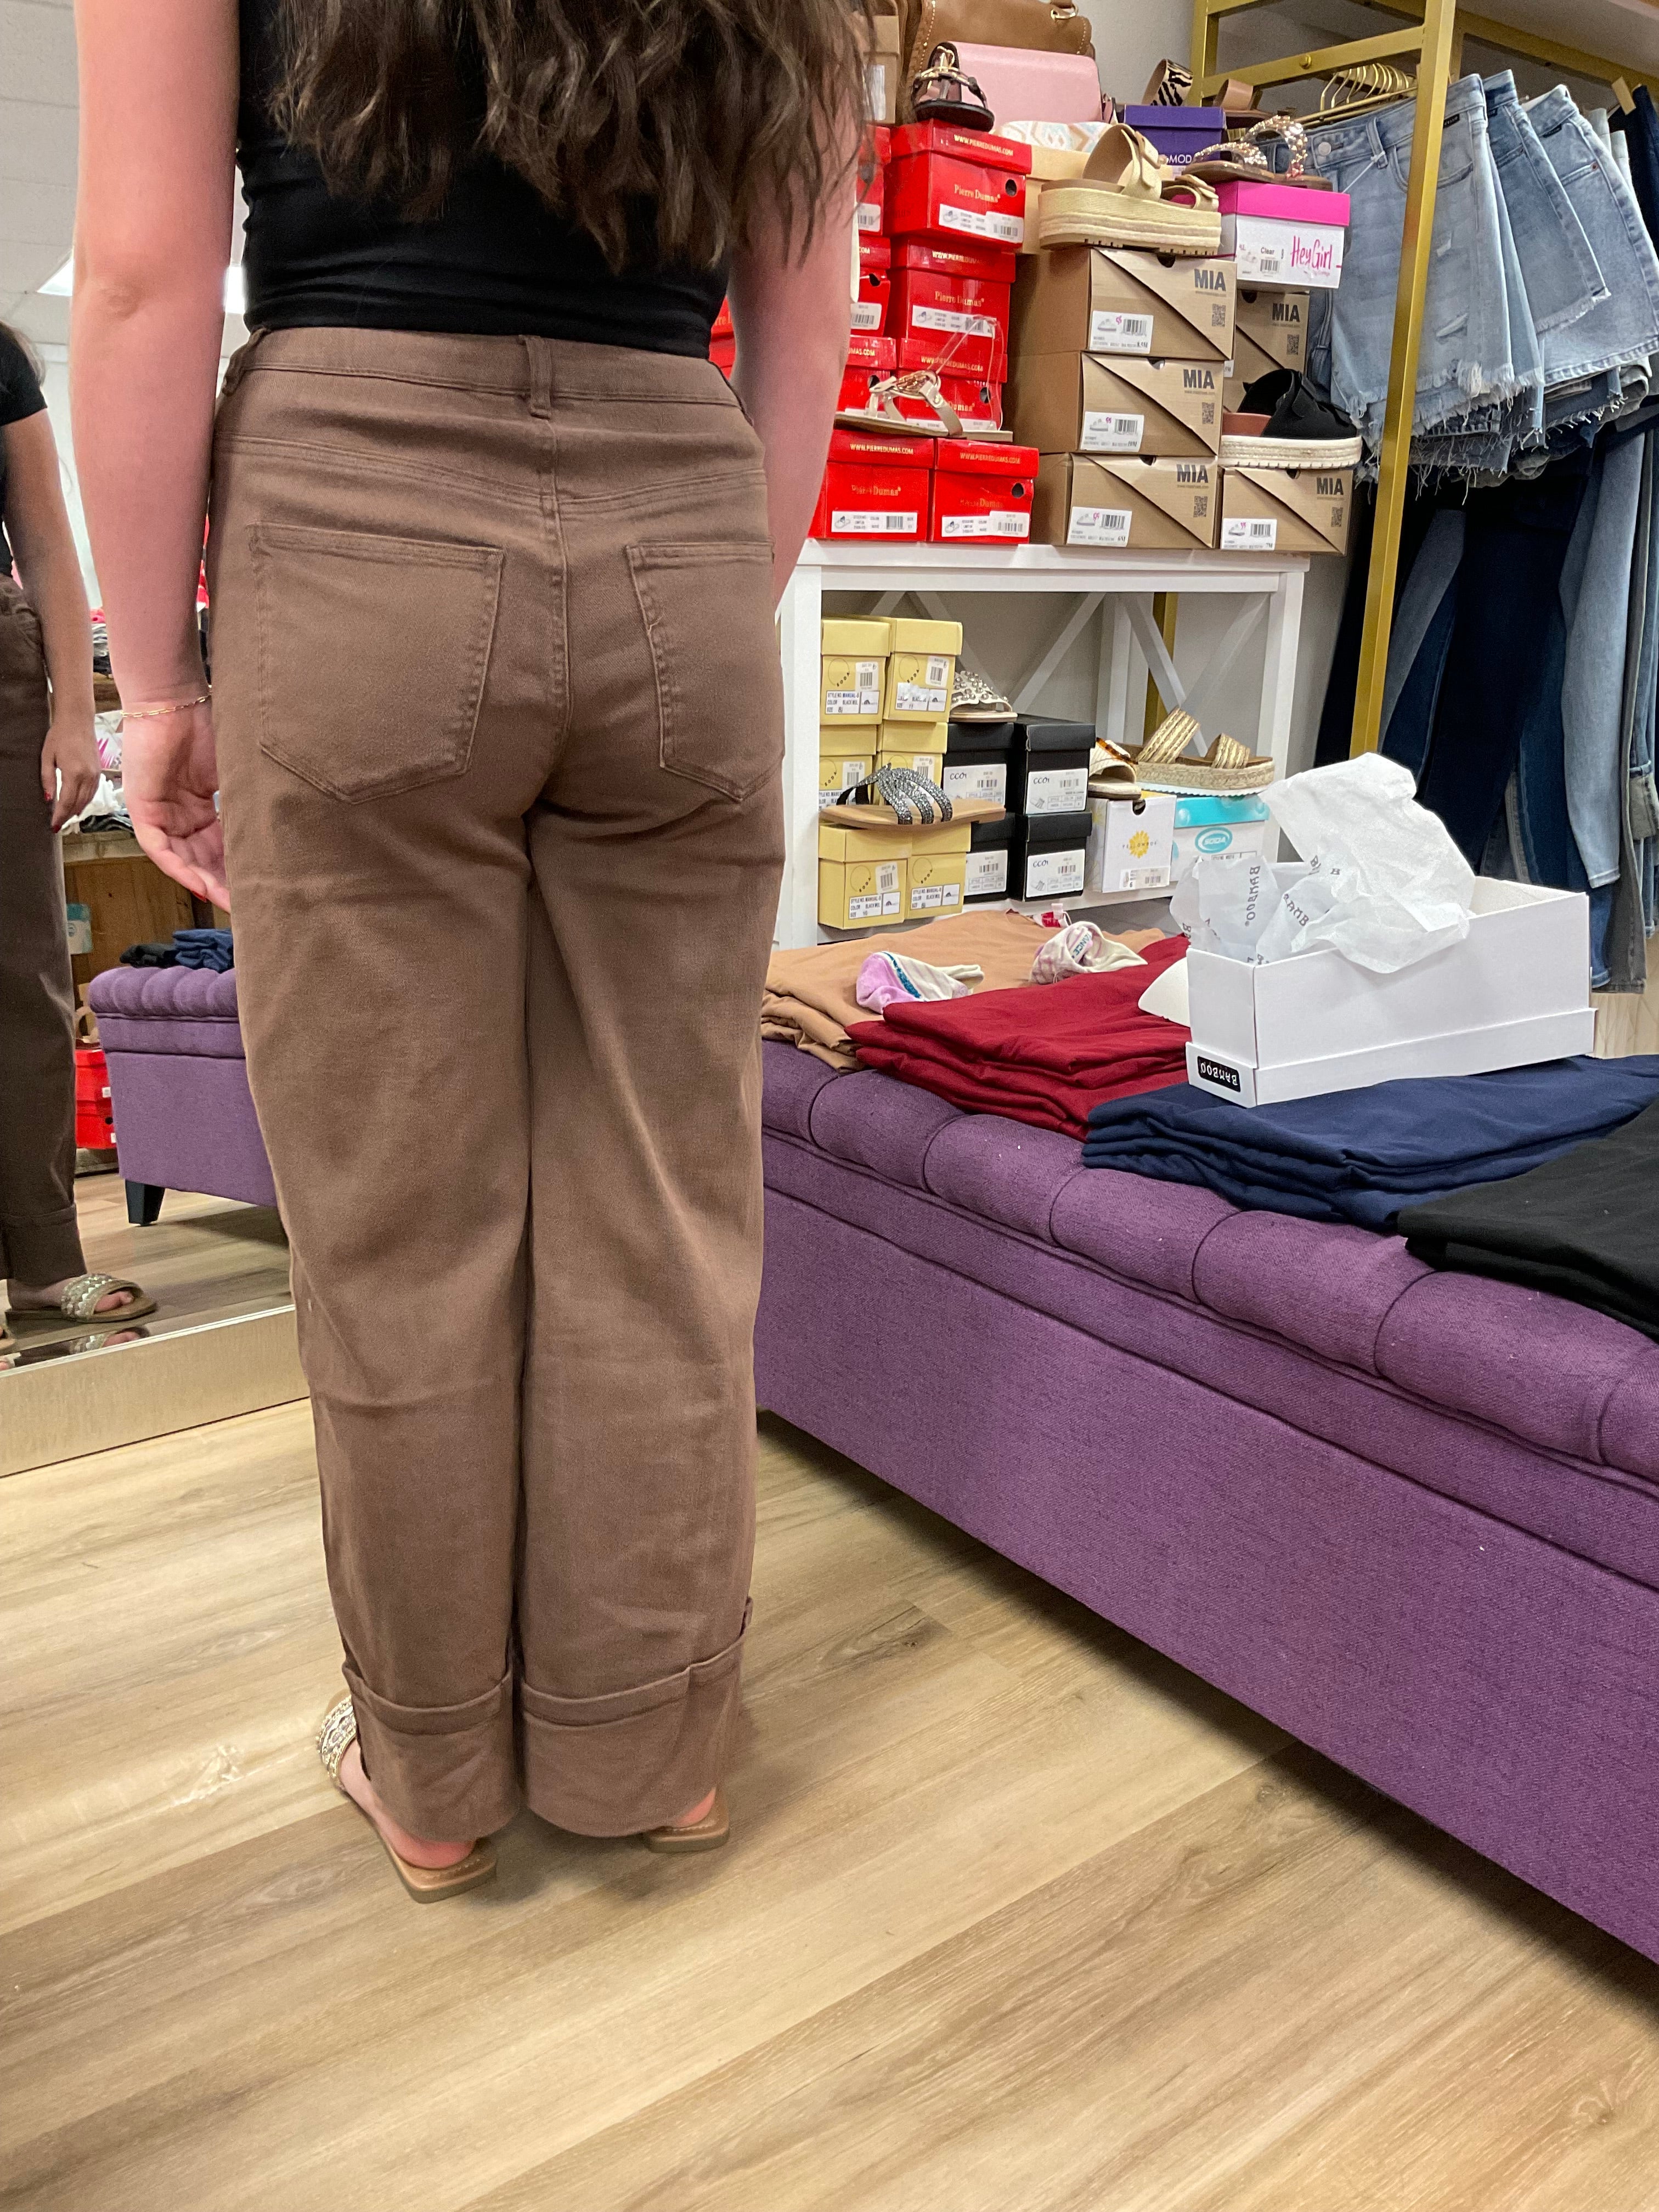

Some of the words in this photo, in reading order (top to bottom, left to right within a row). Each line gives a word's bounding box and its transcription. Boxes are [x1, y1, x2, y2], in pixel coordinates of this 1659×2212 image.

[954, 134, 1013, 156] WWW.PIERREDUMAS.COM
[1169, 154, 1192, 163] MOD
[954, 184, 974, 199] Pierre
[1261, 246, 1274, 255] Clear
[1194, 268, 1227, 291] MIA
[935, 291, 956, 303] Pierre
[1272, 303, 1300, 322] MIA
[1183, 369, 1215, 390] MIA
[850, 444, 913, 455] WWW.PIERREDUMAS.COM
[960, 453, 1020, 464] WWW.PIERREDUMAS.COM
[1176, 464, 1209, 483] MIA
[873, 486, 898, 496] Dumas
[1317, 477, 1344, 495] MIA
[837, 672, 850, 687] SODA
[825, 772, 837, 786] SODA
[1204, 837, 1226, 845] SODA
[859, 877, 871, 893] SODA
[1200, 1063, 1238, 1085] BAMBOO
